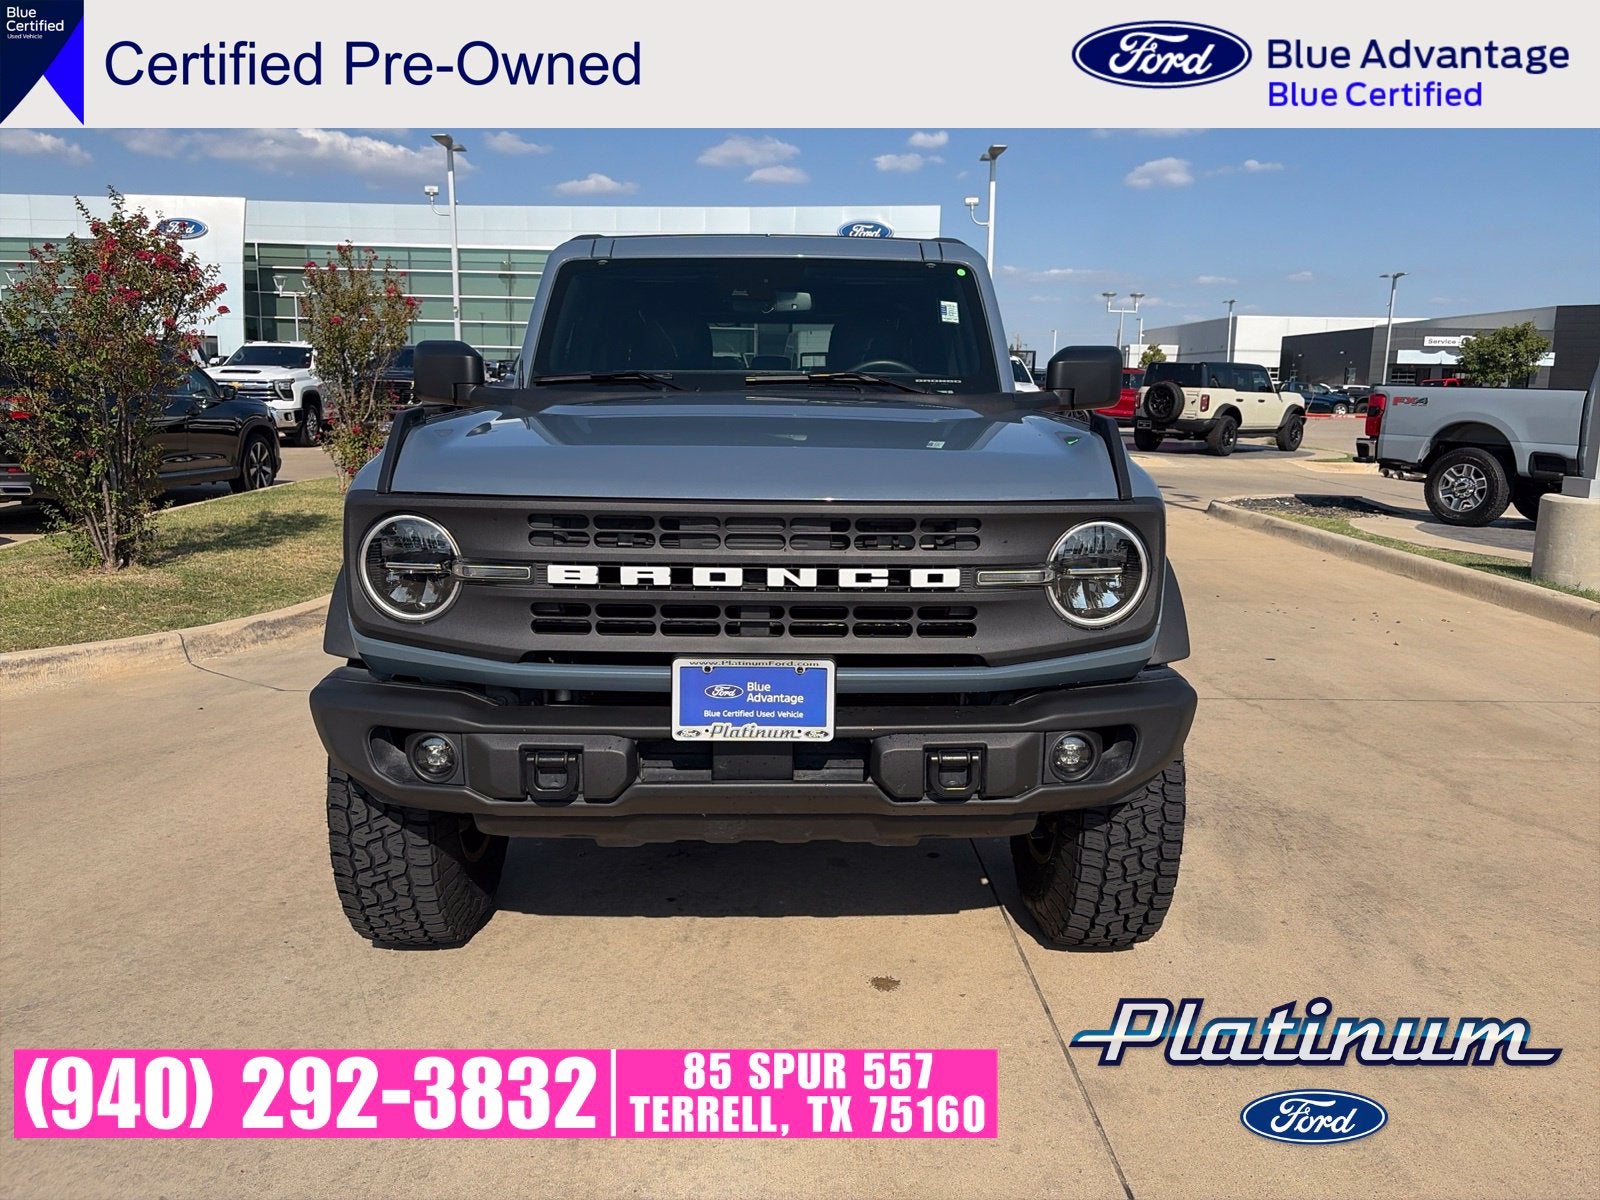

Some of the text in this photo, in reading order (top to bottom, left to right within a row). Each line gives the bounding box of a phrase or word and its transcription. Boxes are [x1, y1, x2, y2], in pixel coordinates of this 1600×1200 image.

[849, 224, 881, 237] Ford
[1392, 397, 1428, 405] FX4
[547, 564, 961, 588] BRONCO
[712, 686, 737, 697] Ford
[747, 682, 772, 692] Blue
[746, 694, 805, 705] Advantage
[703, 710, 722, 718] Blue
[722, 710, 754, 718] Certified
[778, 711, 804, 719] Vehicle
[710, 724, 801, 739] Platinum
